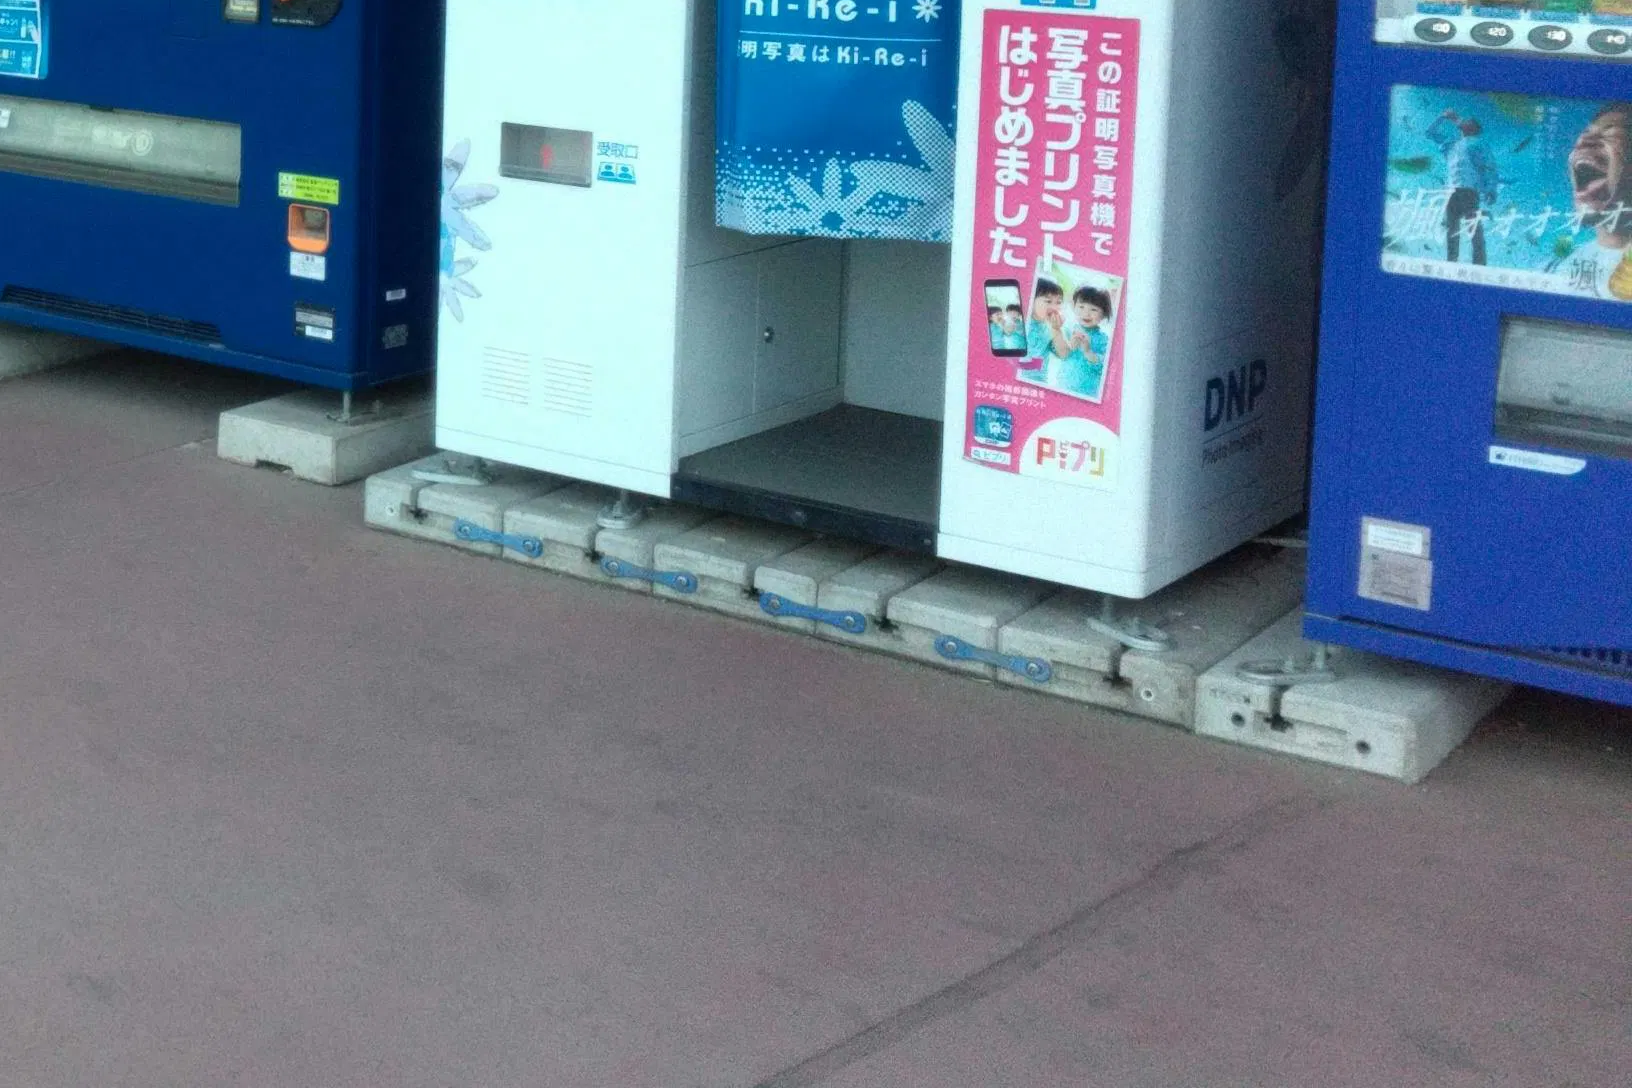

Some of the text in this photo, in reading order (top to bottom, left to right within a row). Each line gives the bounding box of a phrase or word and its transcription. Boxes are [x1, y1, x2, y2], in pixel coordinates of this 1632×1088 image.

[989, 25, 1038, 268] はじめました
[1040, 28, 1089, 272] 写真プリント
[1091, 32, 1123, 256] この証明写真機で
[1204, 358, 1267, 432] DNP
